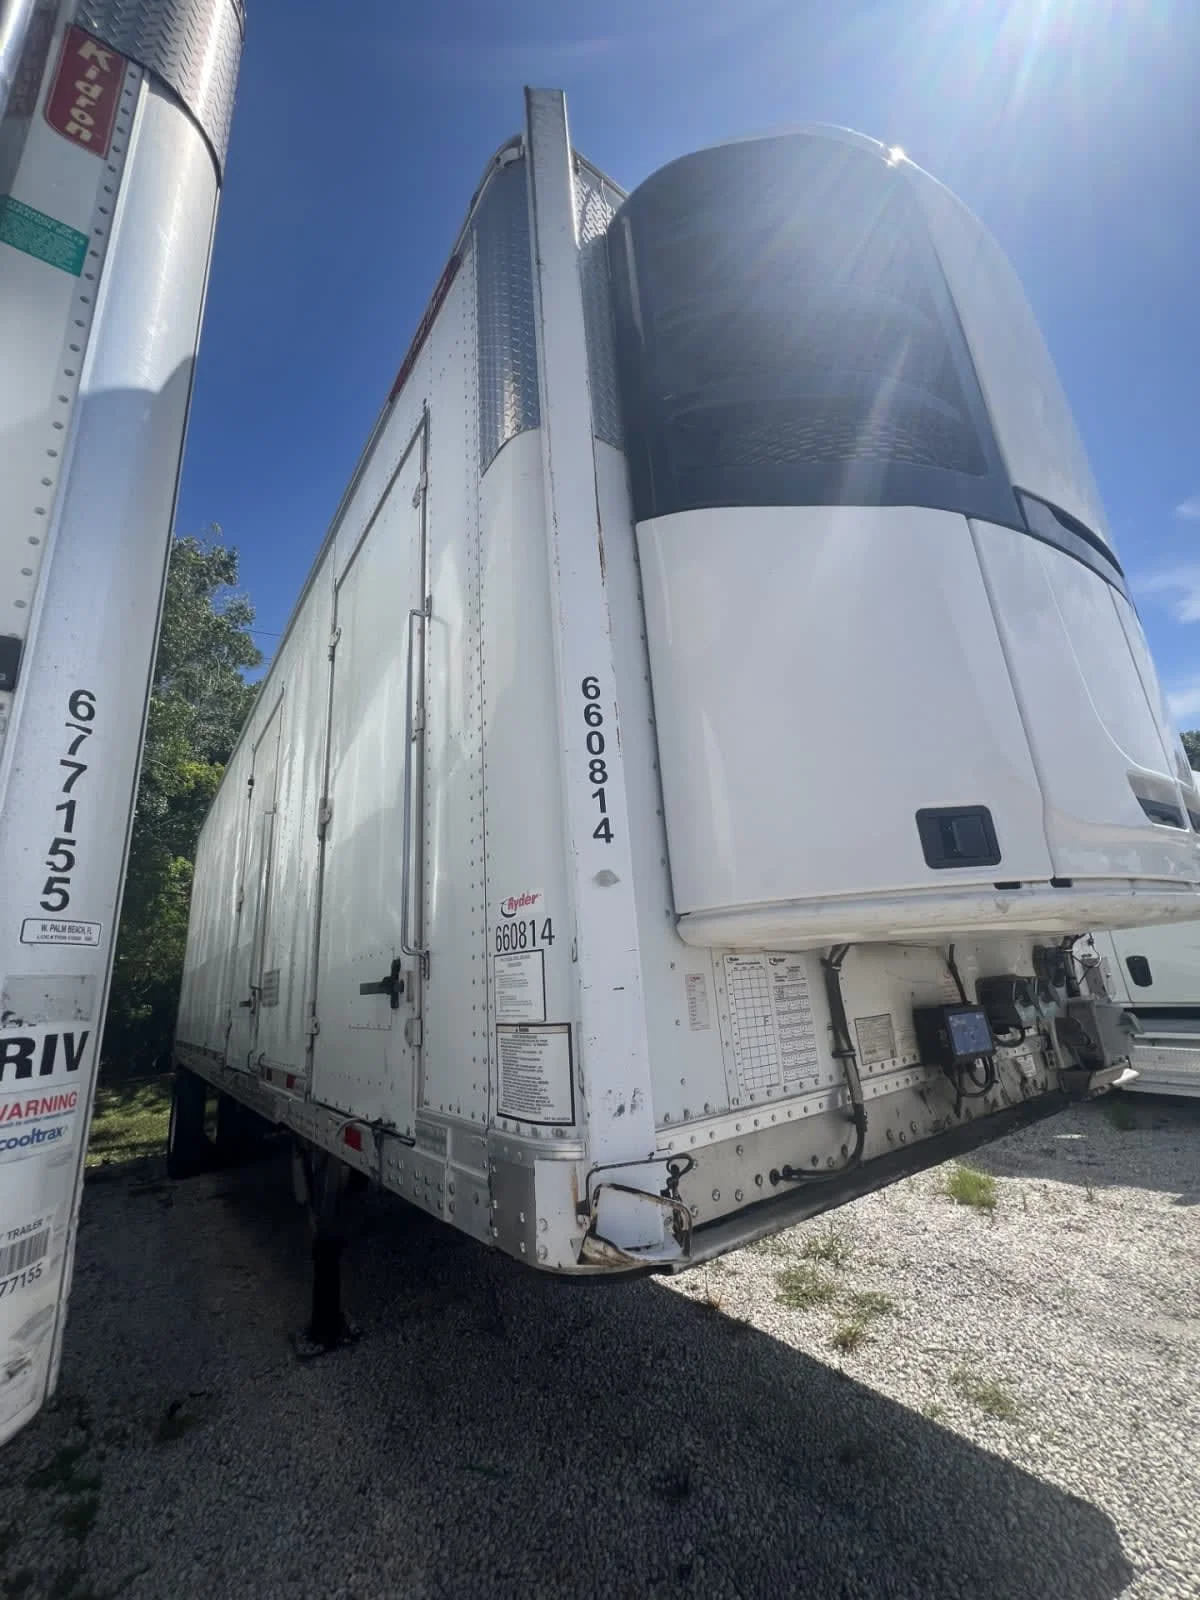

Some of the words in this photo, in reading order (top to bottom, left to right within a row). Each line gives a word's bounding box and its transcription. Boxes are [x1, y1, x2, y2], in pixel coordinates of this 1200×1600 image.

[582, 676, 614, 843] 660814
[39, 688, 97, 912] 677155
[507, 892, 538, 911] Ryder
[50, 924, 67, 933] PALM
[495, 917, 556, 952] 660814
[7, 1218, 43, 1240] TRAILER
